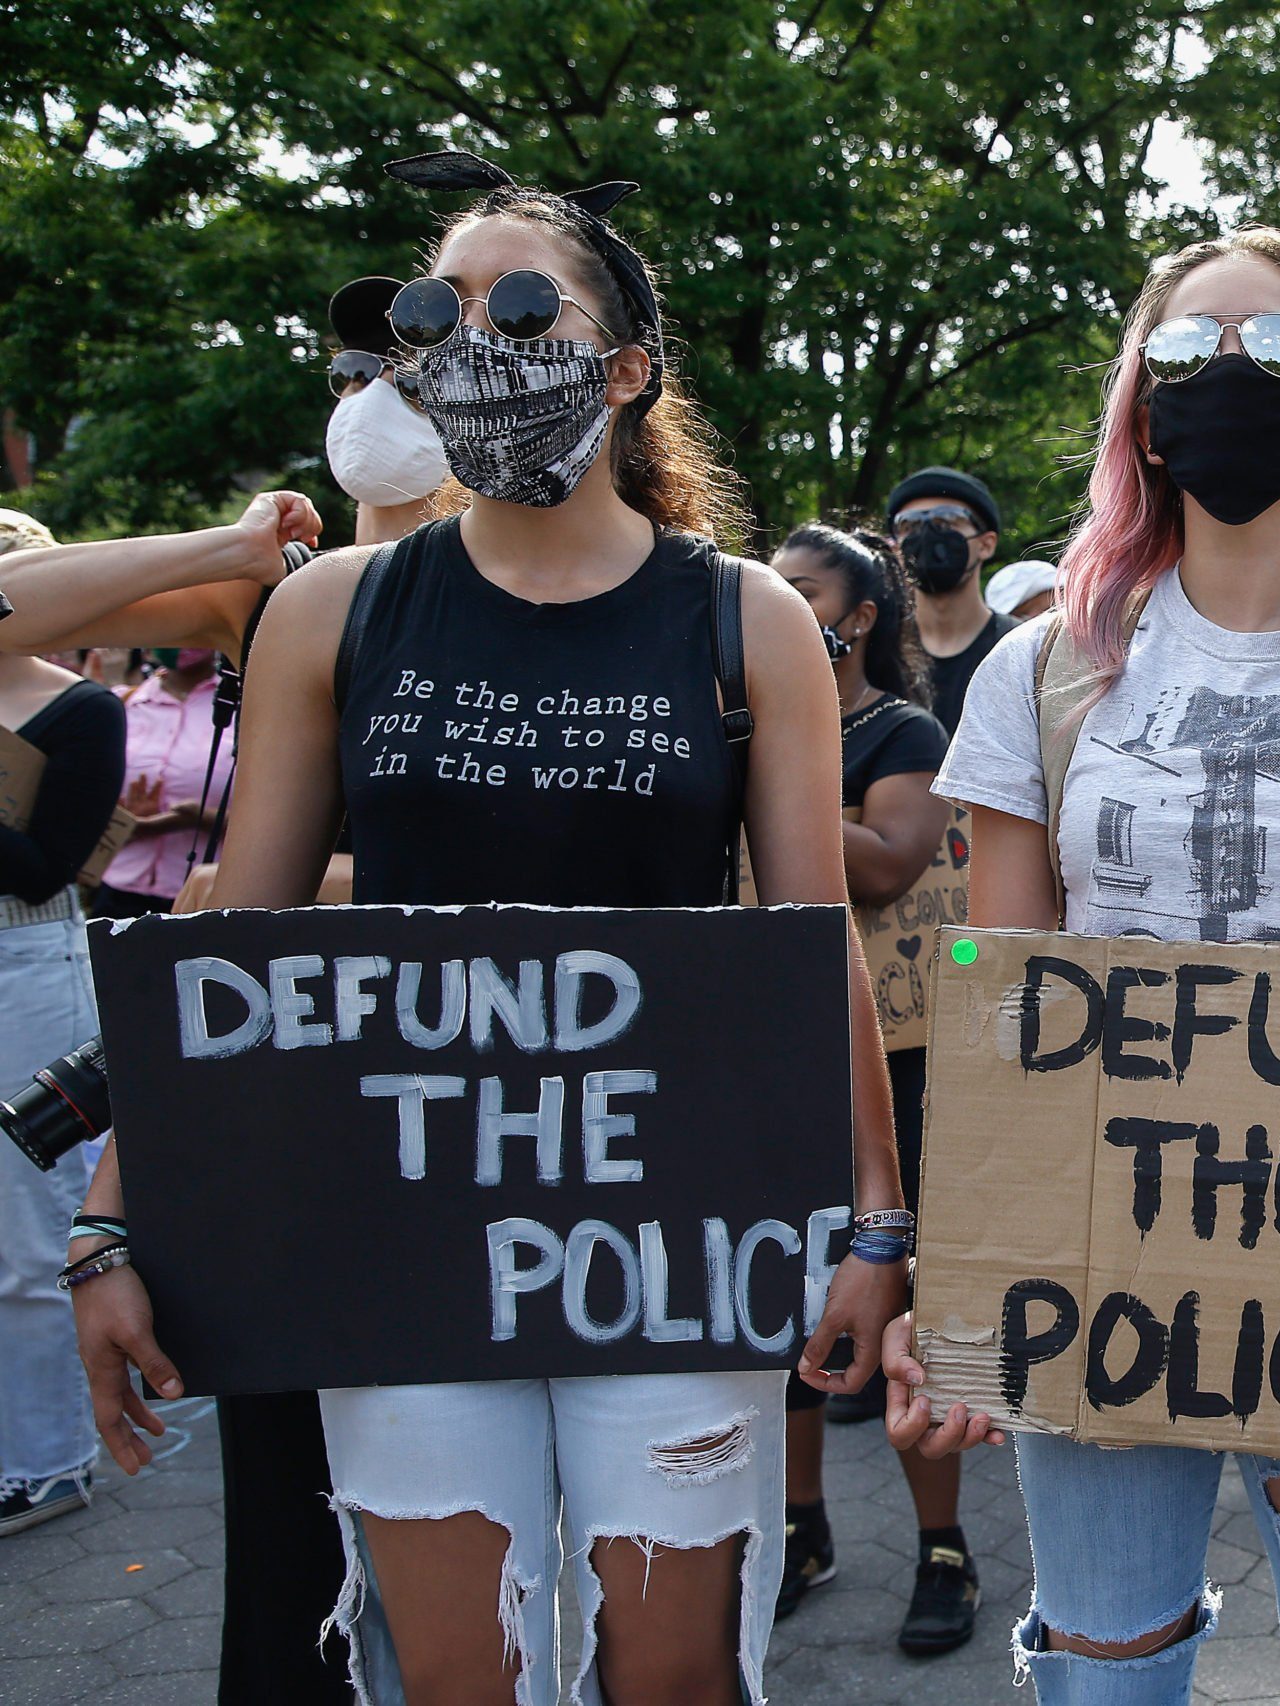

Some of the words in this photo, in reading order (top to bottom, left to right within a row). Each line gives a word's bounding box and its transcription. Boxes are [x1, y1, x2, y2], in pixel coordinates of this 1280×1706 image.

[363, 711, 423, 745] you
[444, 717, 537, 747] wish
[561, 726, 605, 748] to
[627, 728, 690, 758] see
[393, 670, 434, 698] Be
[455, 681, 519, 712] the
[536, 689, 671, 721] change
[369, 746, 408, 777] in
[435, 752, 506, 786] the
[531, 759, 656, 796] world
[174, 949, 643, 1060] DEFUND
[360, 1069, 658, 1187] THE
[487, 1206, 852, 1354] POLICE
